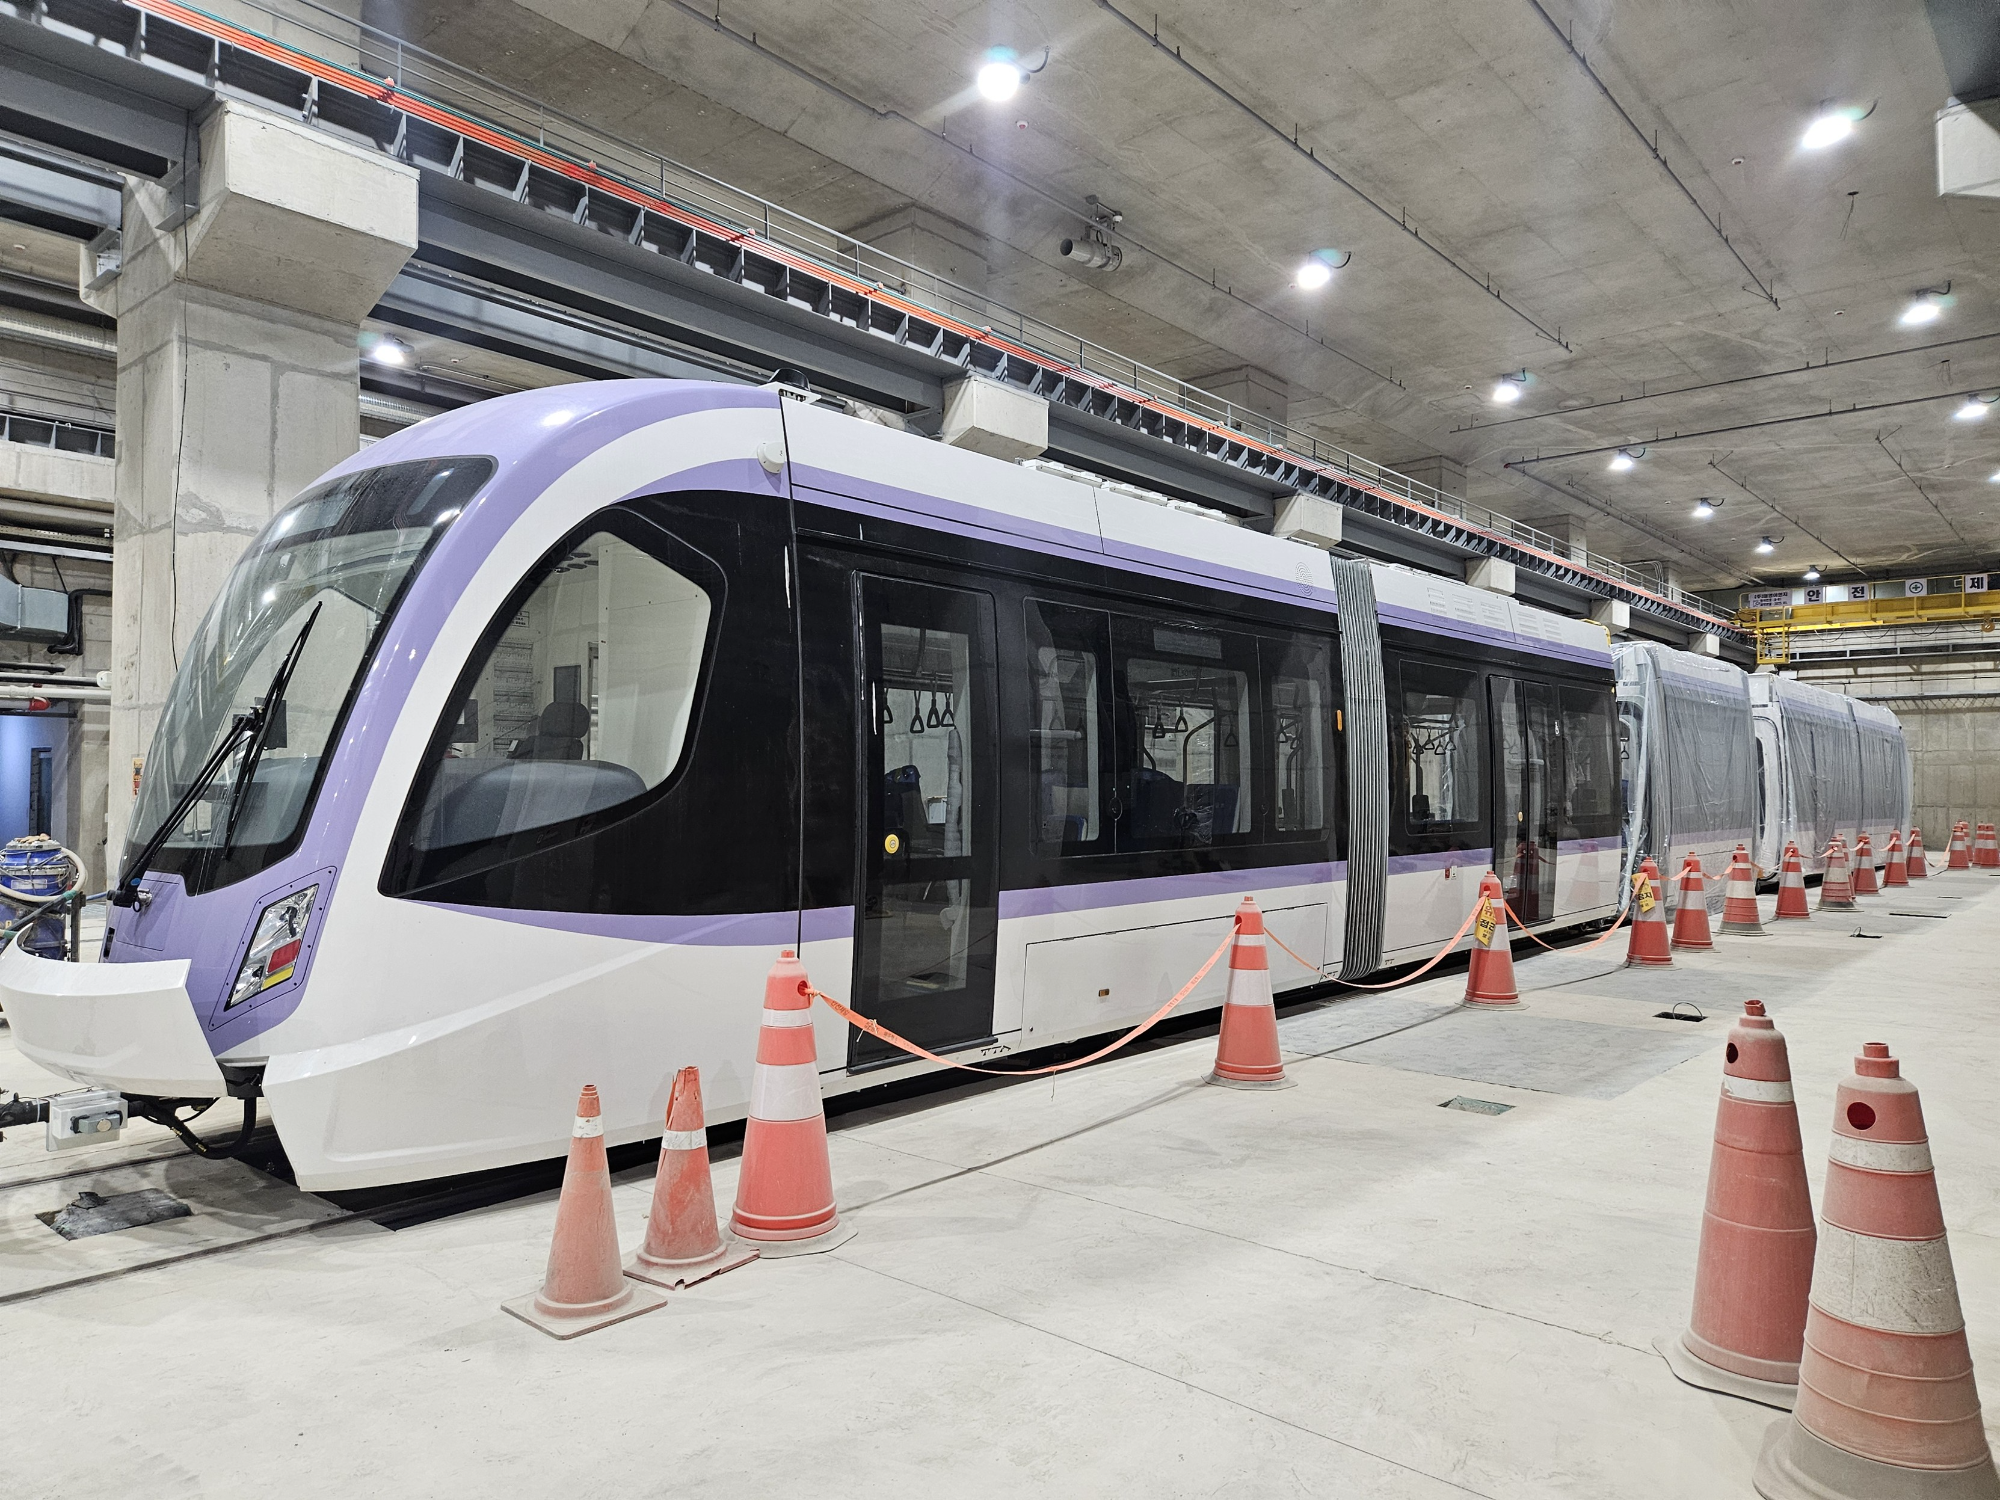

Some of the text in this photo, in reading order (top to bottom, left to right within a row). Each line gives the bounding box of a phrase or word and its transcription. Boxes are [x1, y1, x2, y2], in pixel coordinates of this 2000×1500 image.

[1807, 576, 1984, 602] 안 전 제
